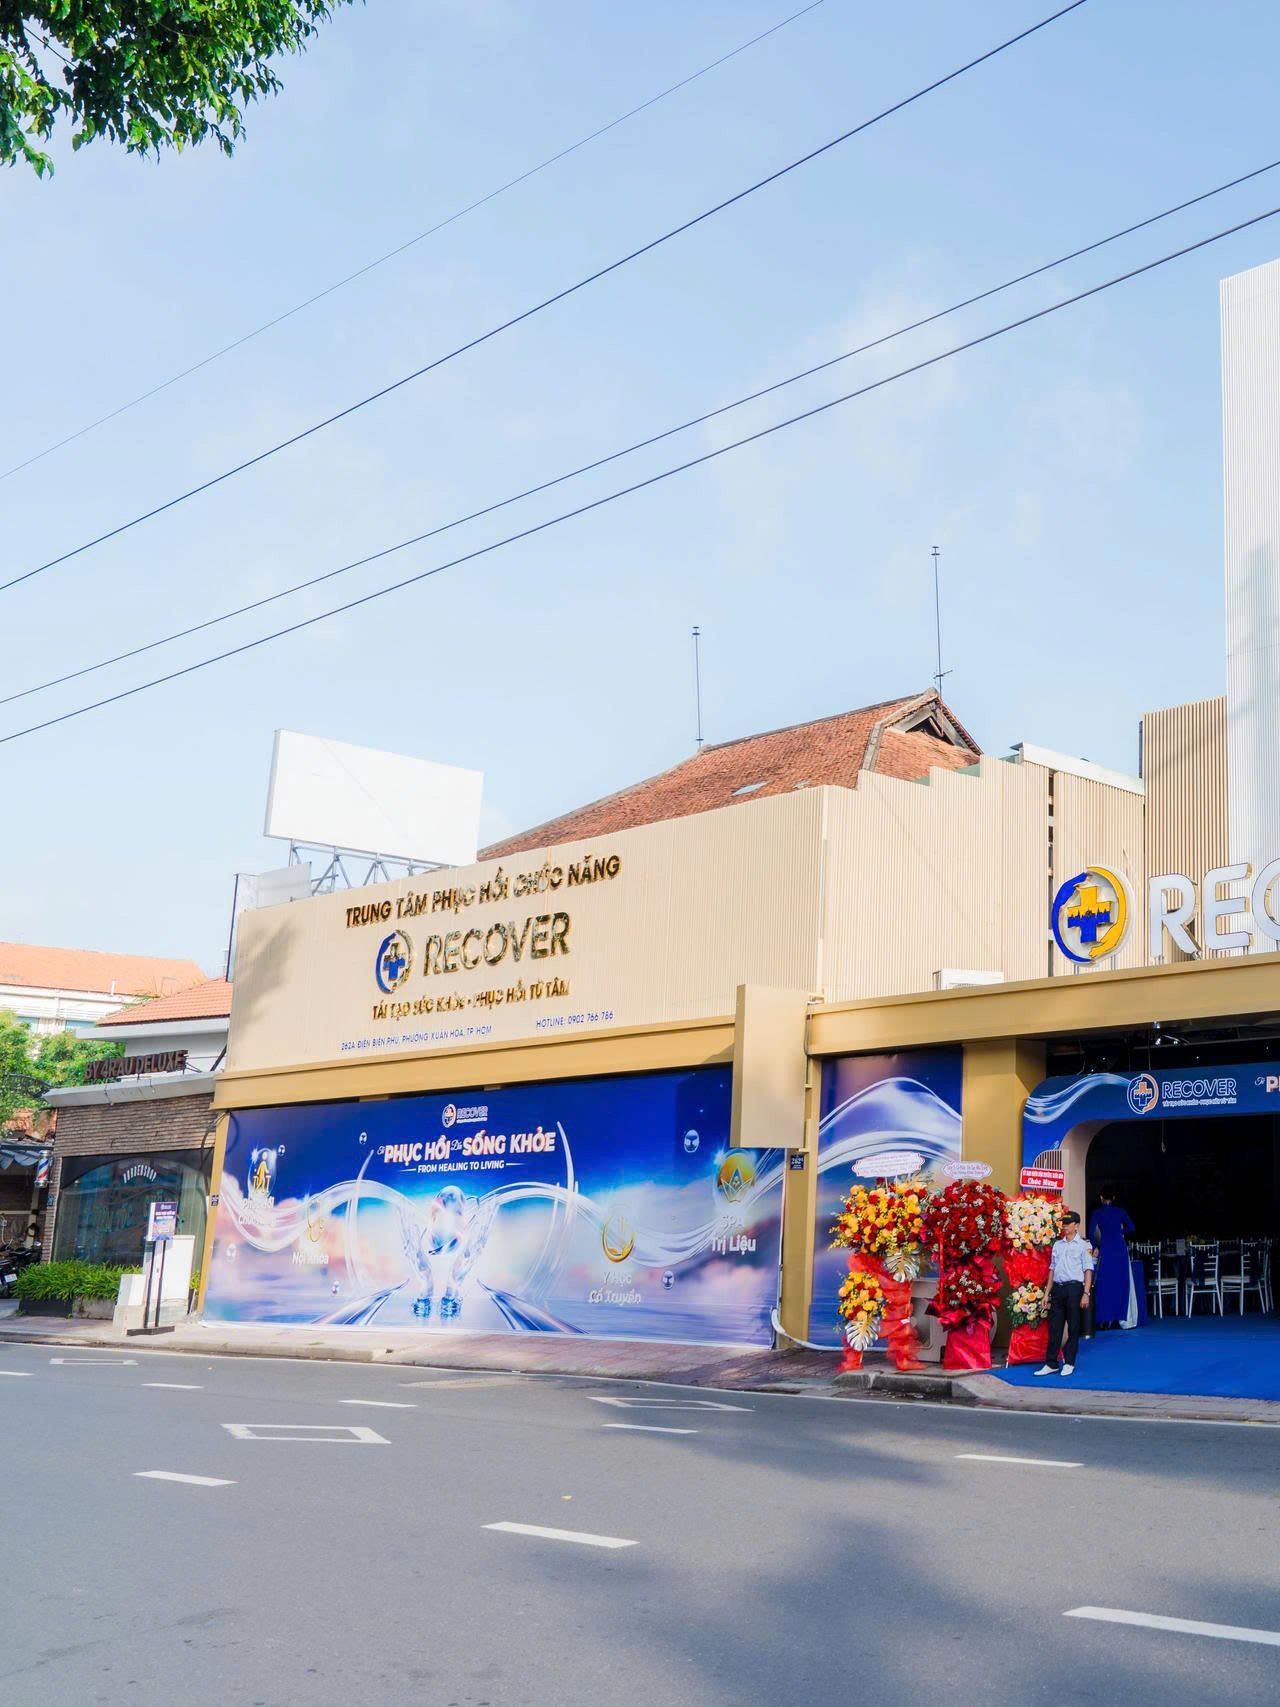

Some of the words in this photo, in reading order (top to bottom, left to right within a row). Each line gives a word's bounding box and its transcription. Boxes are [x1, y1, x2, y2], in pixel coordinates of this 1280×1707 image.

[345, 900, 392, 928] TRUNG
[396, 891, 428, 919] TÂM
[431, 885, 477, 914] PHỤC
[479, 866, 510, 905] HỒI
[513, 862, 564, 896] CHỨC
[566, 855, 622, 888] NĂNG
[424, 911, 571, 977] RECOVER
[568, 1014, 585, 1025] 0902
[587, 1013, 599, 1023] 766
[601, 1011, 614, 1021] 786
[135, 1050, 188, 1074] DELUXE
[1162, 1078, 1236, 1099] RECOVER
[383, 1141, 424, 1167] PHỤC
[424, 1134, 451, 1161] HỒI
[462, 1129, 507, 1157] SỐNG
[509, 1125, 557, 1154] KHỎE
[417, 1162, 438, 1174] FROM
[438, 1160, 469, 1173] HEALING
[469, 1160, 480, 1171] TO
[480, 1159, 505, 1170] LIVING
[729, 1233, 757, 1256] Liệu
